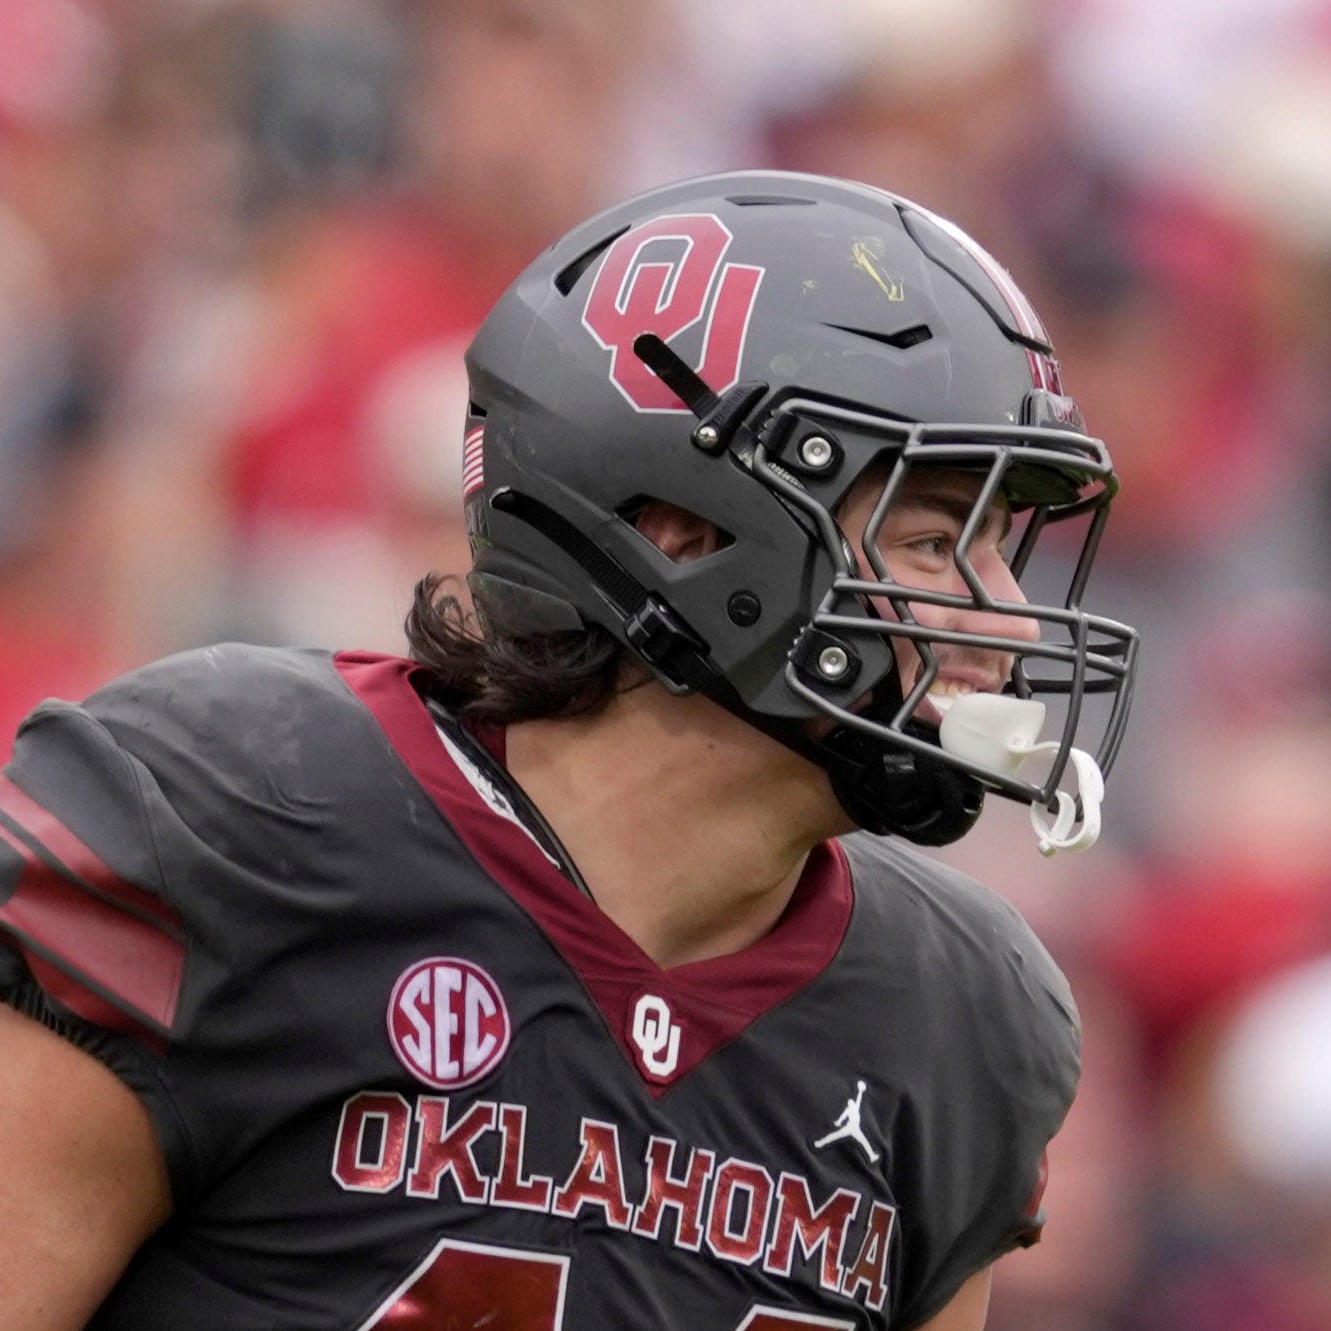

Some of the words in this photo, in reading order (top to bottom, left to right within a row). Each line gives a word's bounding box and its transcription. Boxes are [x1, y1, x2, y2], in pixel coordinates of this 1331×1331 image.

[581, 212, 765, 414] OU
[399, 966, 497, 1079] SEC
[632, 994, 681, 1077] OU
[330, 1090, 897, 1312] OKLAHOMA
